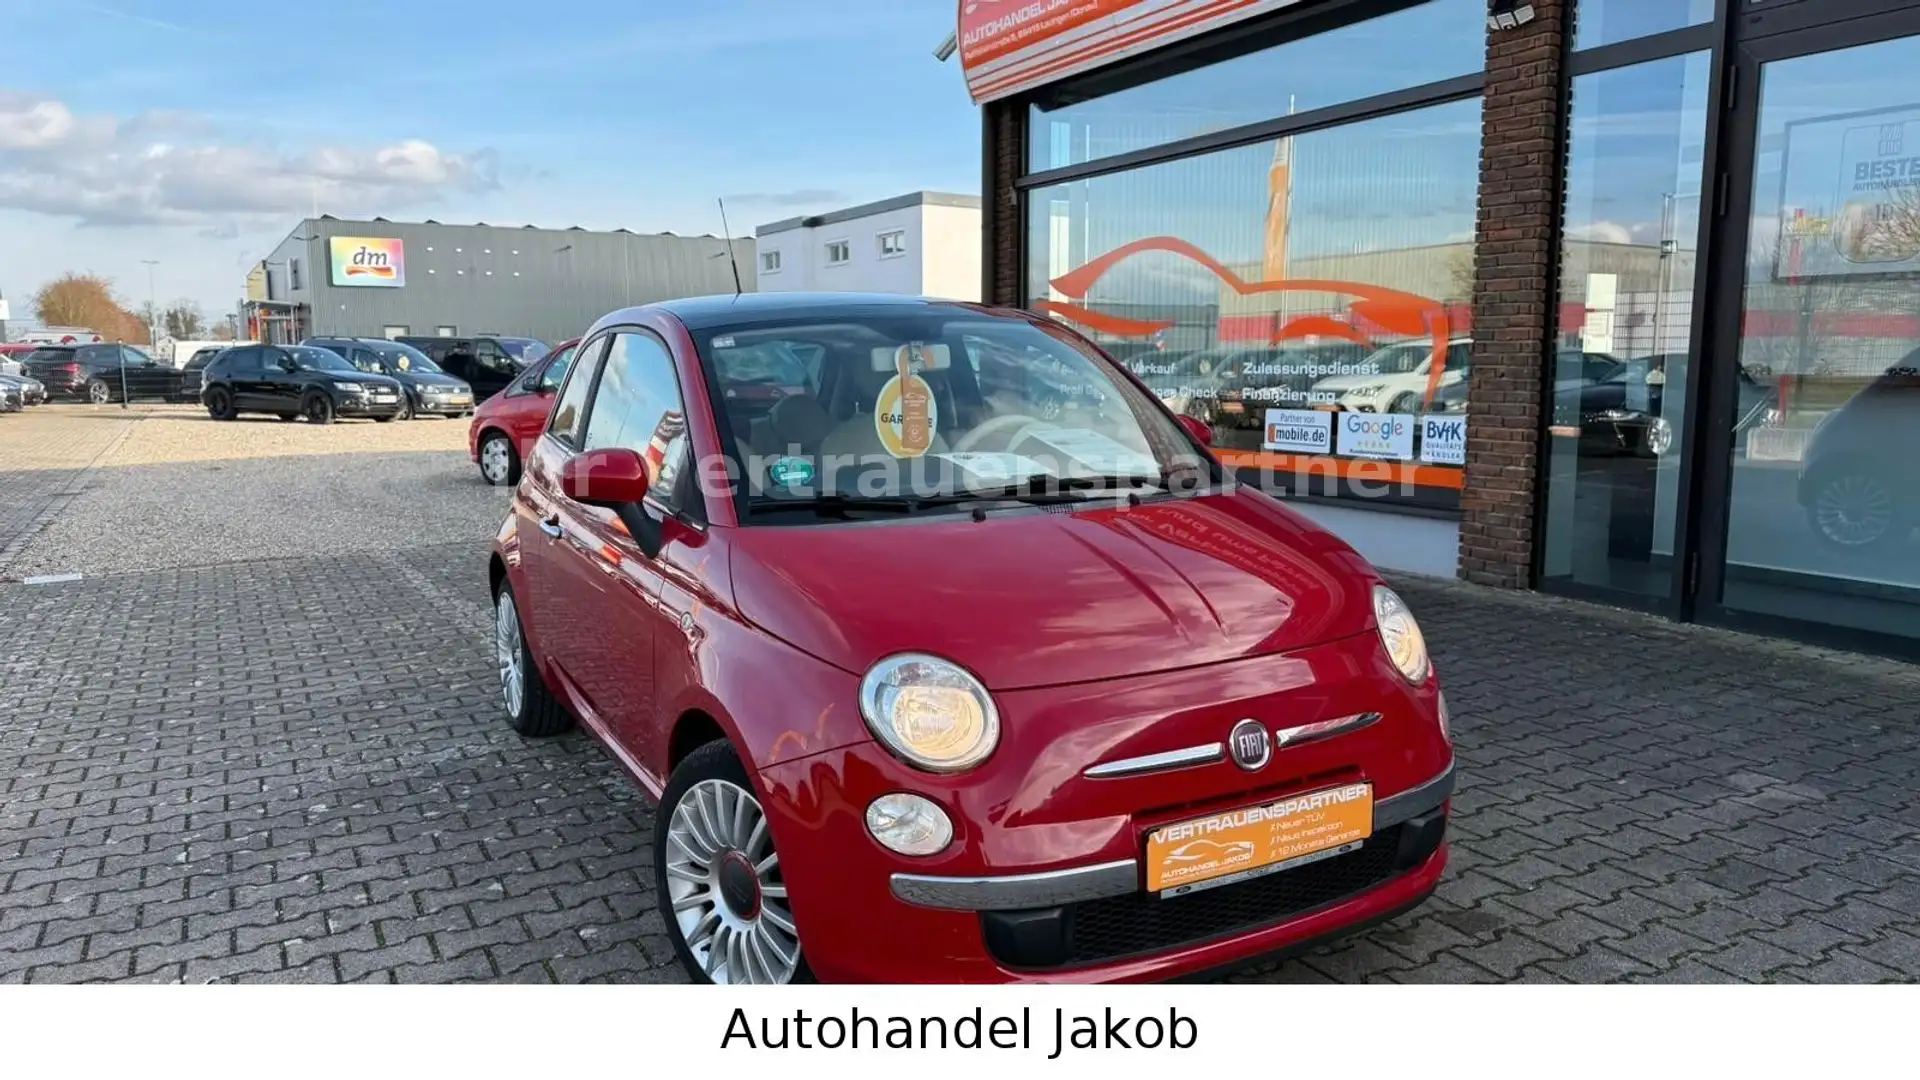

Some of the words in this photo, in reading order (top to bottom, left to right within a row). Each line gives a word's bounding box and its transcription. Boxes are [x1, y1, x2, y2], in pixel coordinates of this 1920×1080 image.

[963, 2, 1046, 46] AUTOHANDEL
[353, 246, 388, 266] dm
[1242, 361, 1380, 377] Zulassungsdienst
[1180, 385, 1218, 399] Check
[1242, 387, 1337, 404] Finanzierung
[1276, 426, 1325, 443] mobile.de
[1347, 414, 1403, 440] Google
[1238, 732, 1262, 758] FIAT
[1153, 783, 1368, 844] VERTRAUENSPARTNER
